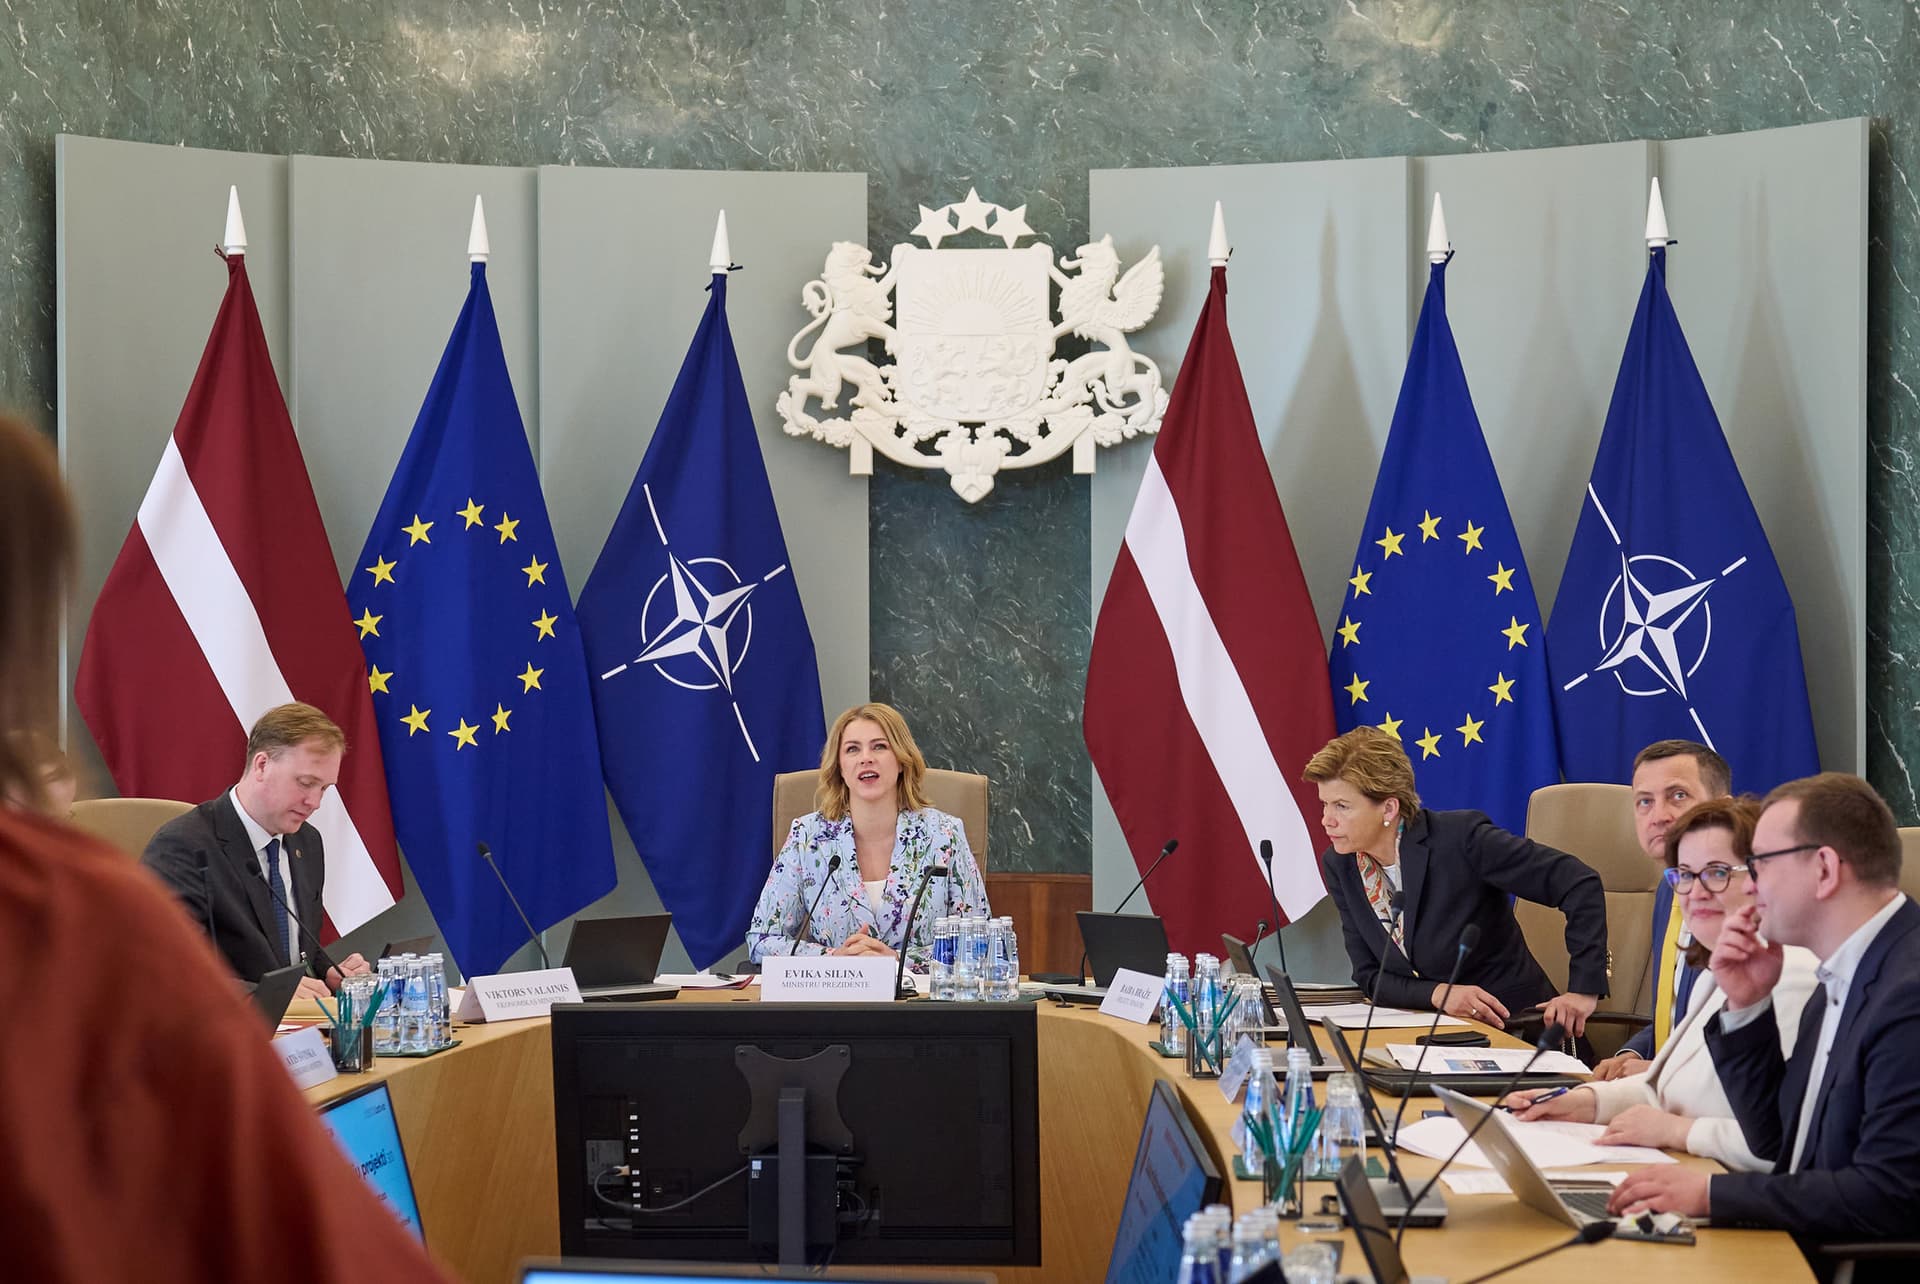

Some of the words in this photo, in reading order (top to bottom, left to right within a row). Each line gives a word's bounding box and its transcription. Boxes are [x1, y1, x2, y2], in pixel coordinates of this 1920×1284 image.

[785, 969, 821, 978] EVIKA
[825, 969, 864, 980] SILIŅA
[782, 981, 820, 989] MINISTRU
[485, 987, 526, 1000] VIKTORS
[527, 984, 570, 995] VALAINIS
[361, 1148, 388, 1179] projekti
